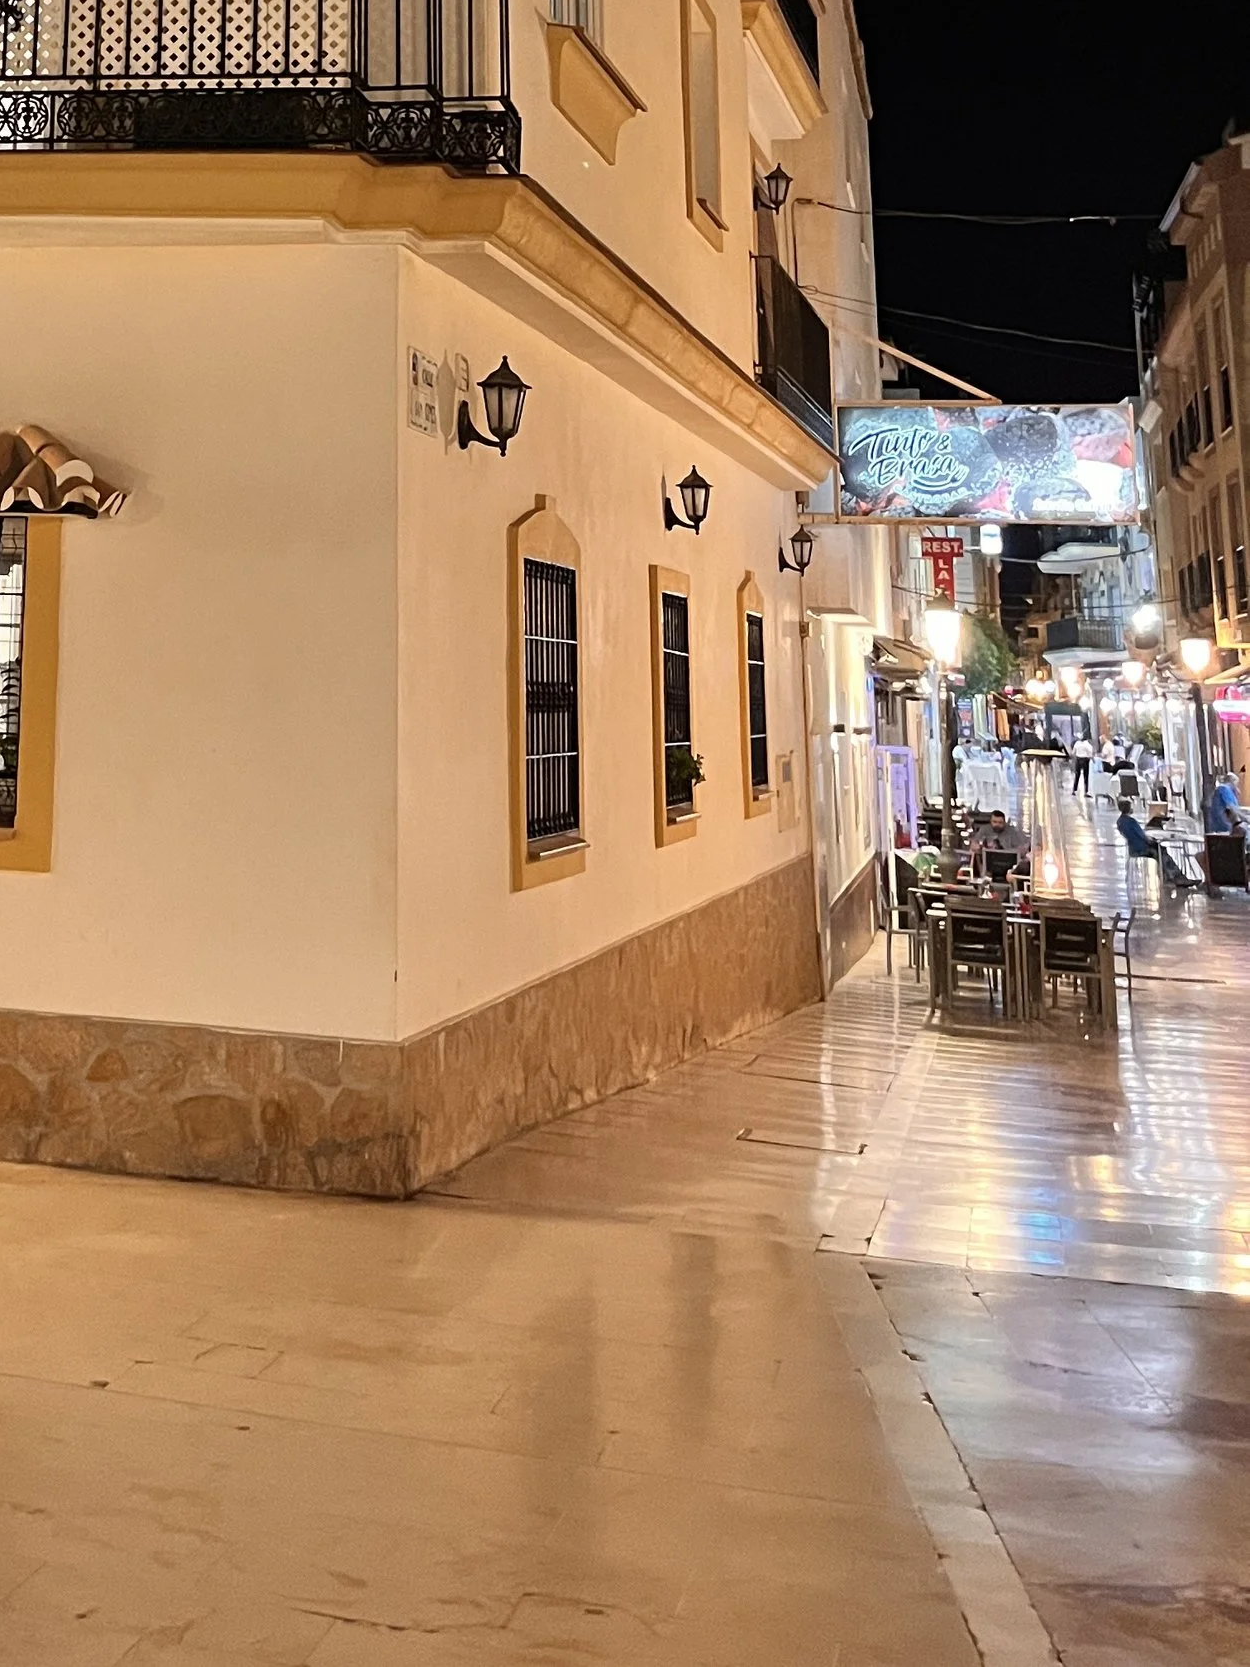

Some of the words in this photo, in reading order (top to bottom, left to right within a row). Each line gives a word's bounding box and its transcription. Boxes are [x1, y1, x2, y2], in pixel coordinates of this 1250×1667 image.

[849, 426, 937, 460] Tinto
[937, 433, 950, 451] &
[869, 455, 956, 486] Brasa
[922, 541, 963, 553] REST.
